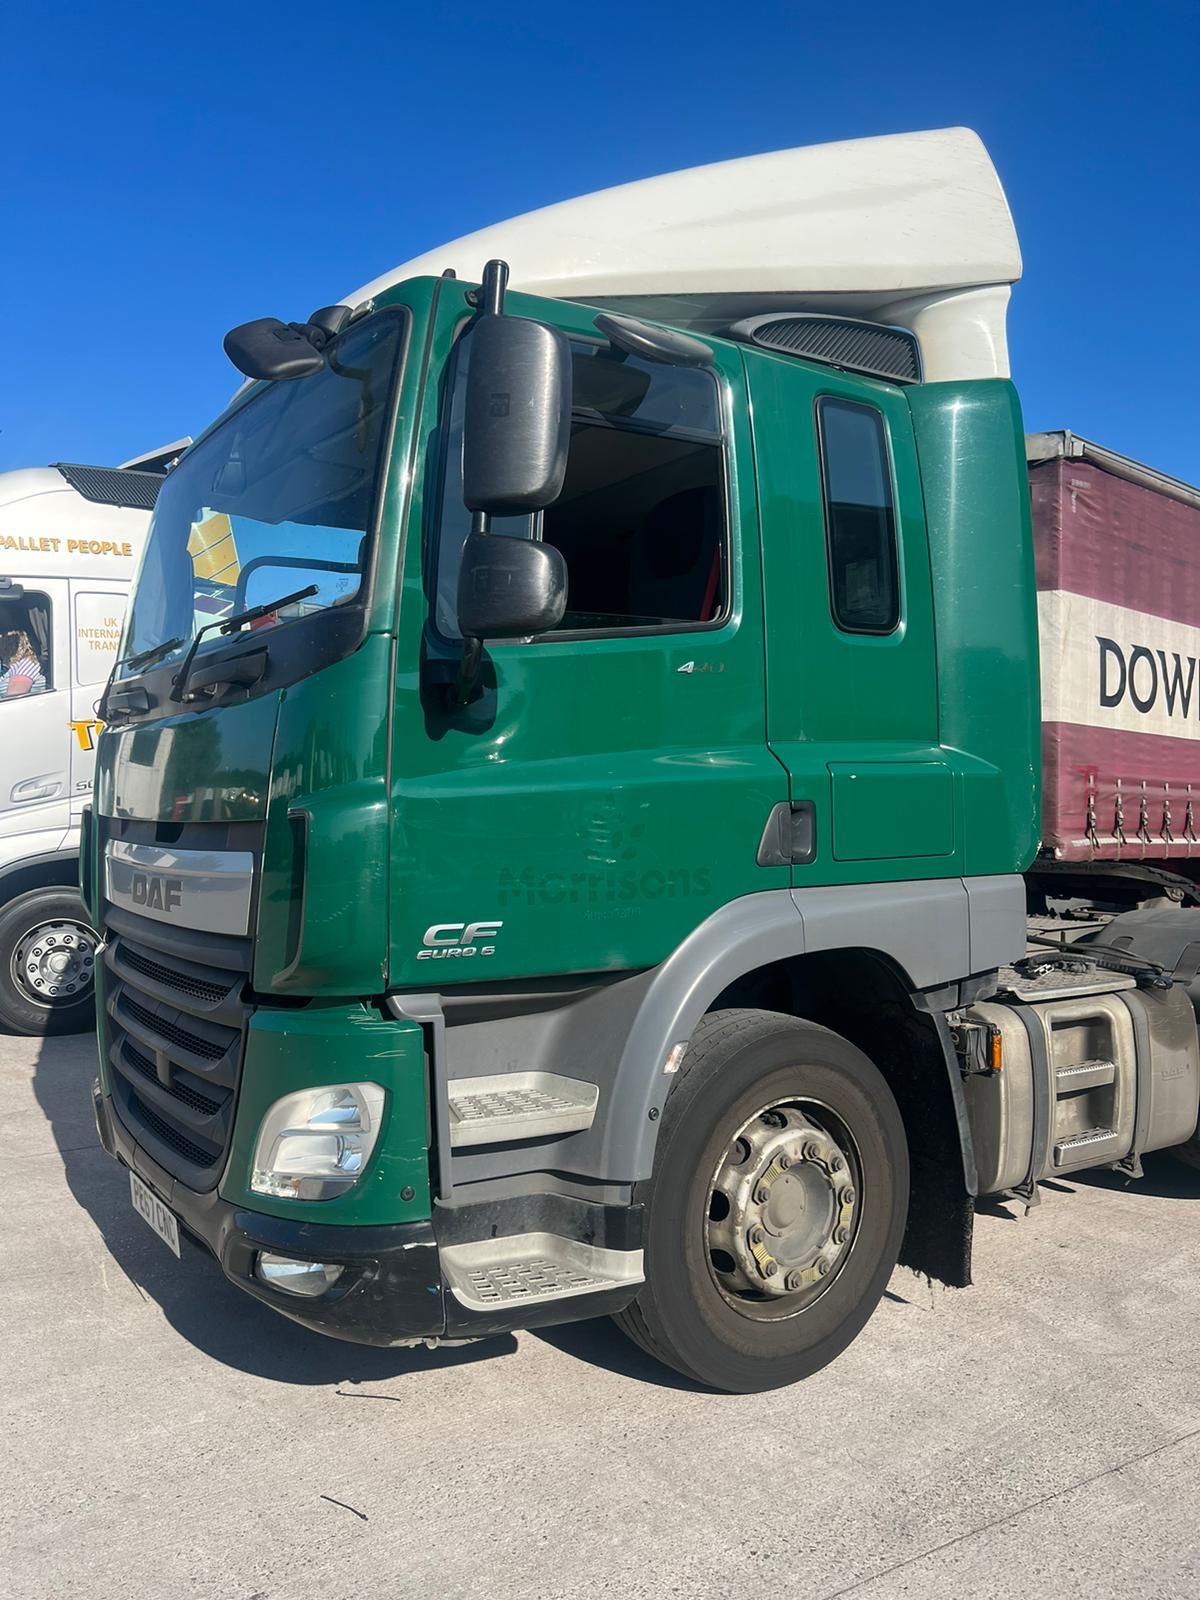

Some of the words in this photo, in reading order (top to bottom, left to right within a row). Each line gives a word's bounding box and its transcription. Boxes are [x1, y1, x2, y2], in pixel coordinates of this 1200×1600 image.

[67, 538, 132, 556] PEOPLE
[103, 617, 118, 628] UK
[1095, 635, 1200, 719] DOW
[132, 873, 184, 912] DAF
[497, 866, 711, 907] Morrisons
[422, 921, 503, 947] CF
[416, 947, 477, 960] EURO
[480, 946, 496, 956] 6
